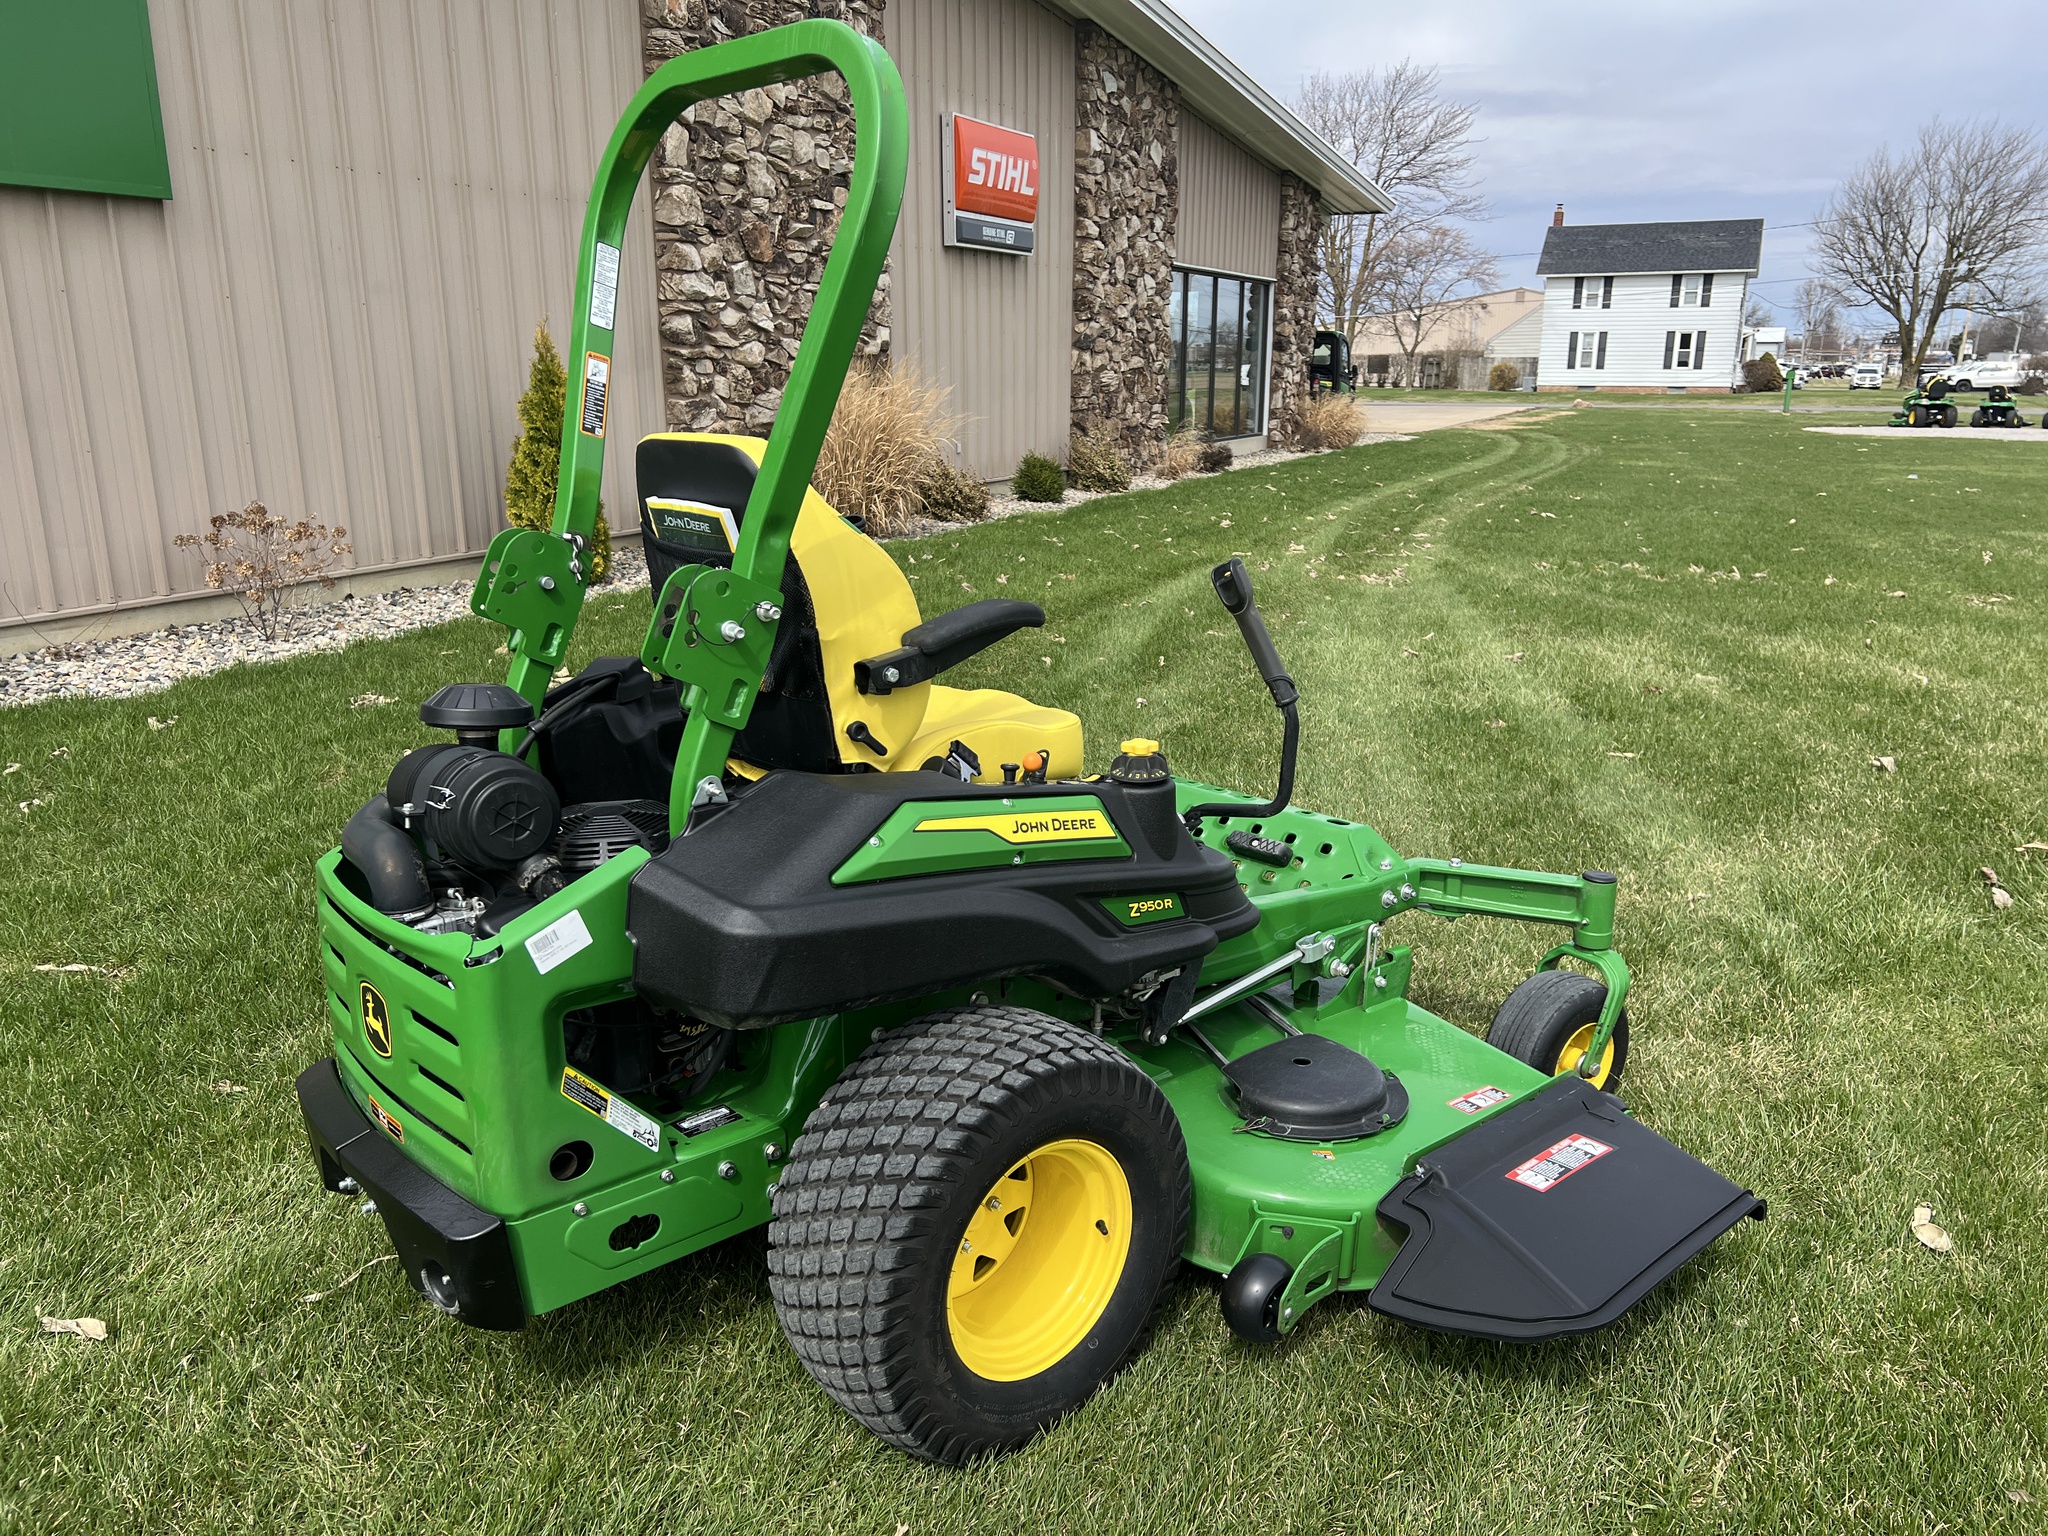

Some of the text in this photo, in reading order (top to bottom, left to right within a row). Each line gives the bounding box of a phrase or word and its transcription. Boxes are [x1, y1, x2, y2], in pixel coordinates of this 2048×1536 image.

[967, 147, 1035, 196] STIHL
[663, 514, 711, 533] JOHN DEERE
[1012, 818, 1096, 834] JOHN DEERE
[1128, 898, 1173, 918] Z950R
[579, 1076, 600, 1093] CAUTION
